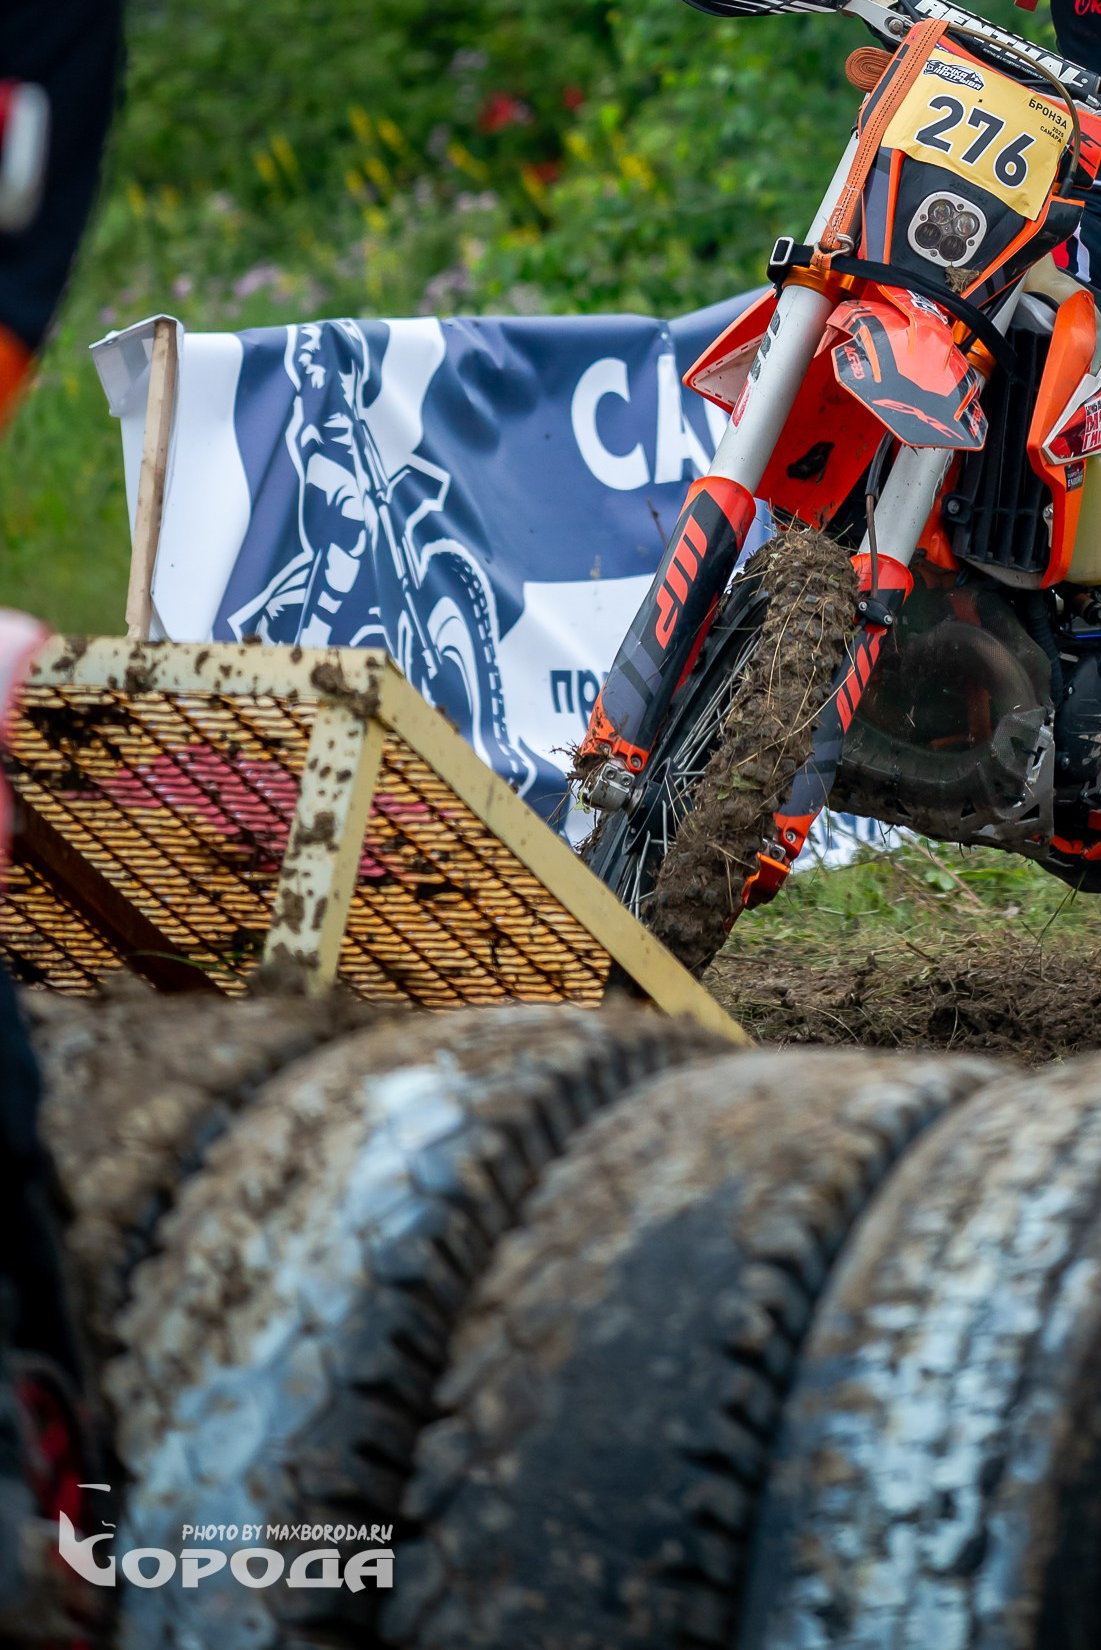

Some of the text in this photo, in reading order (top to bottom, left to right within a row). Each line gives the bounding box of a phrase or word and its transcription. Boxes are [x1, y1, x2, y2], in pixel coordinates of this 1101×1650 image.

[914, 94, 1036, 189] 276
[1027, 98, 1067, 130] БРОНЗА
[1039, 125, 1063, 144] САМАРА
[571, 353, 732, 490] СА
